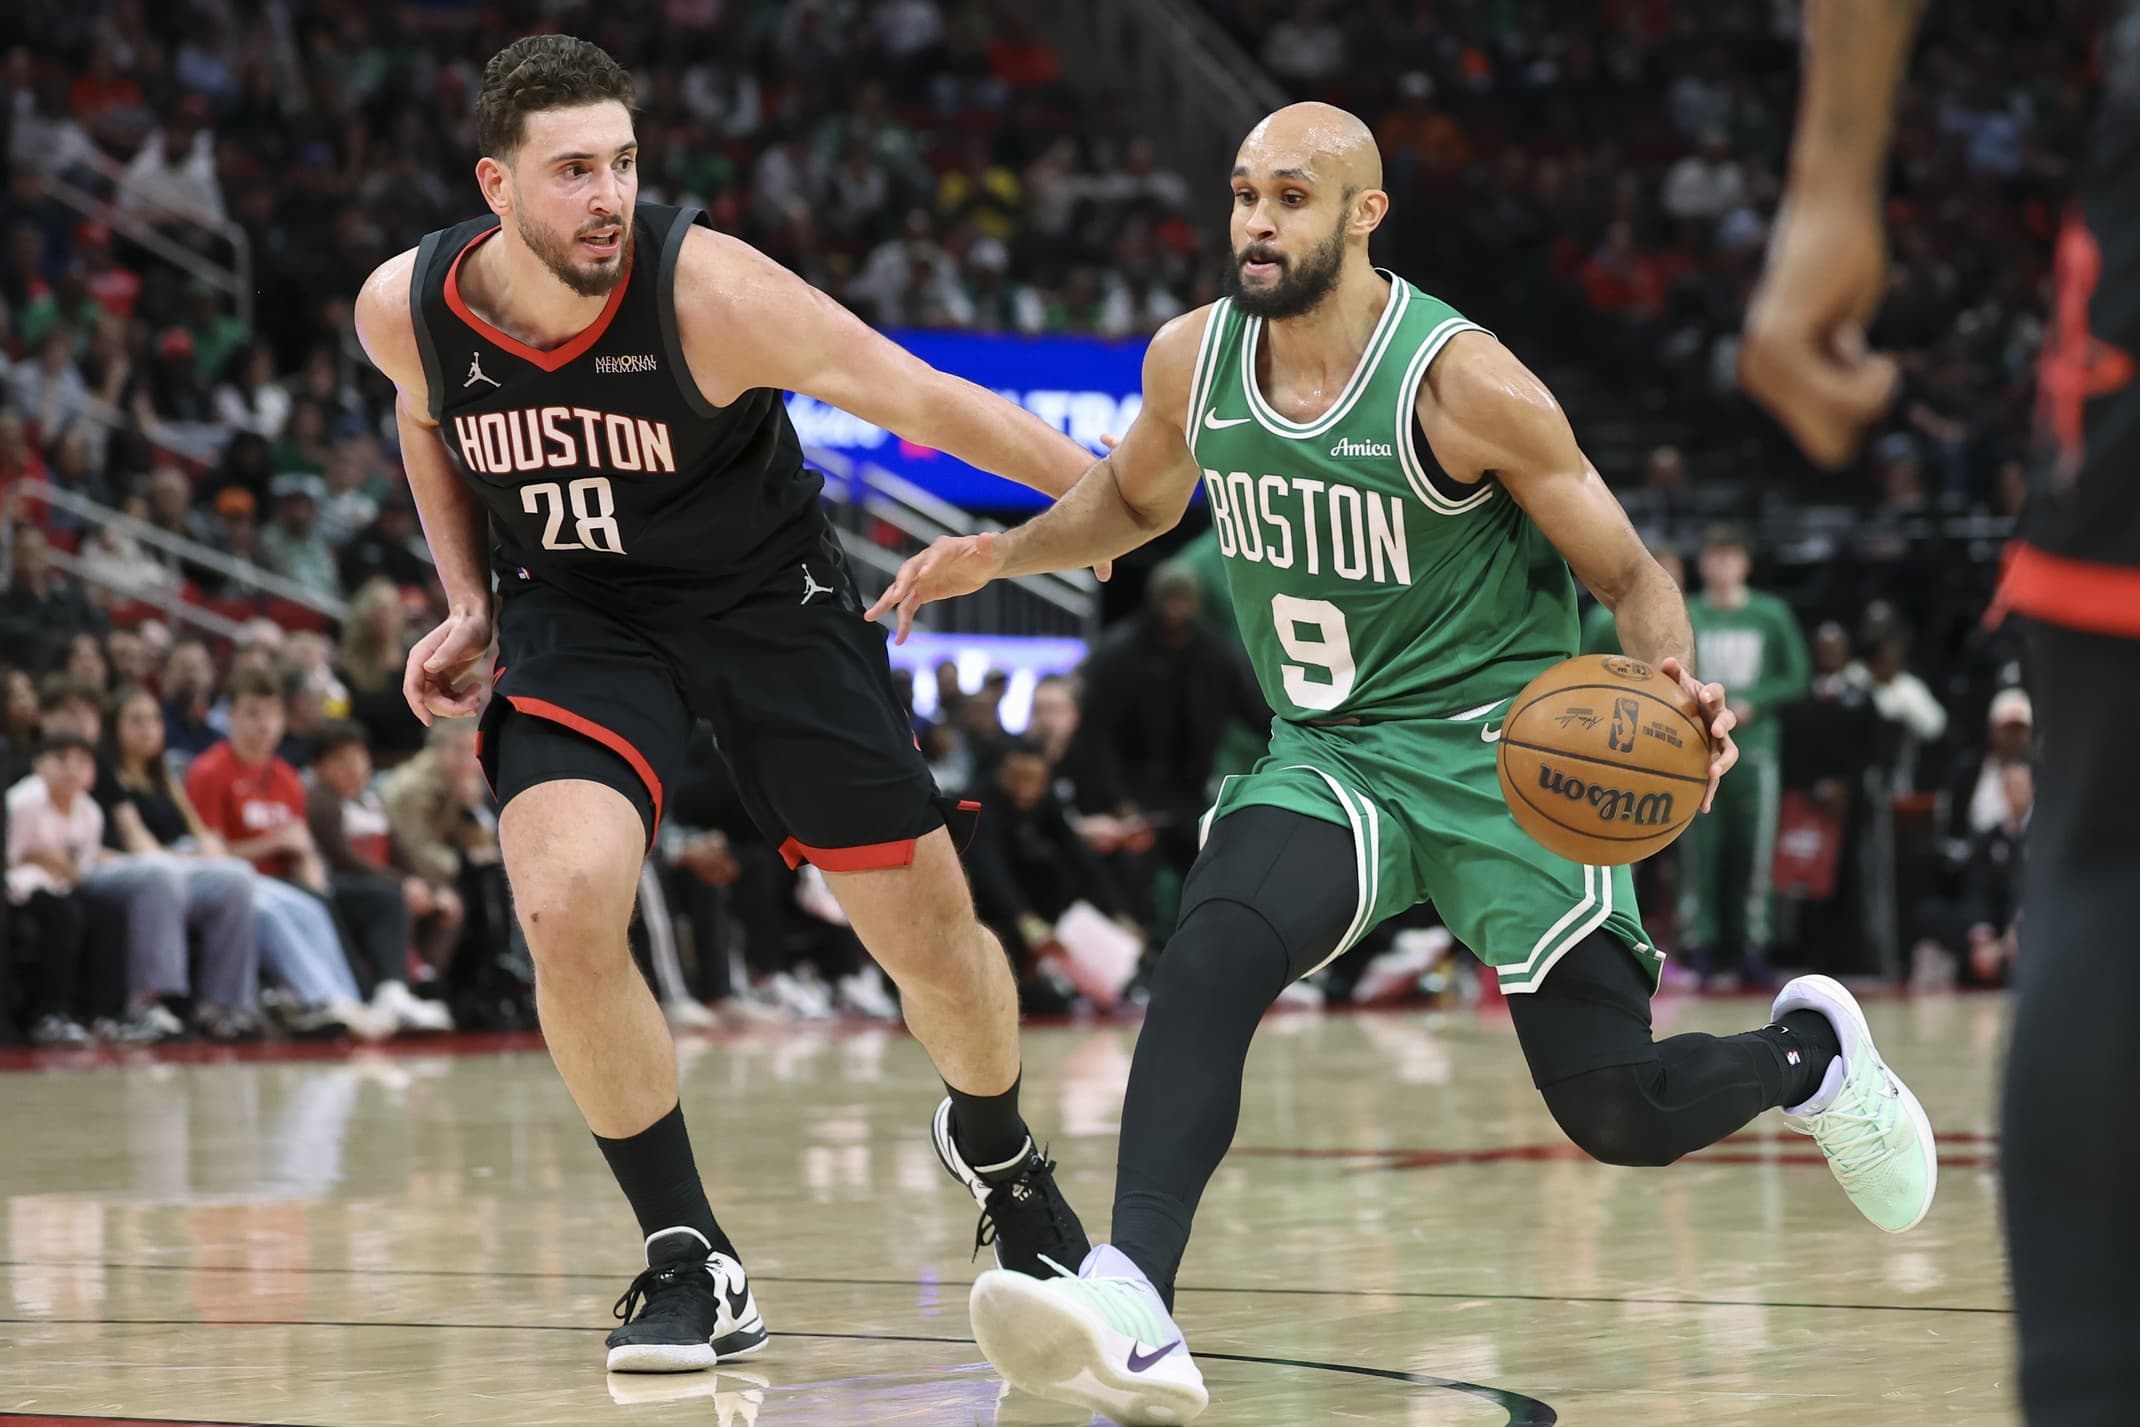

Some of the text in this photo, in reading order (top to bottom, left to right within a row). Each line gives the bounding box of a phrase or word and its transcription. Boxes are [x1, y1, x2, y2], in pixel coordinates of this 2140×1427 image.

[595, 354, 656, 365] MEMORIAL
[595, 361, 657, 373] HERMANN
[454, 407, 677, 473] HOUSTON
[1330, 437, 1392, 457] Amica
[520, 476, 627, 555] 28
[1203, 468, 1412, 586] BOSTON
[1271, 592, 1357, 712] 9
[1539, 763, 1673, 826] Wilson
